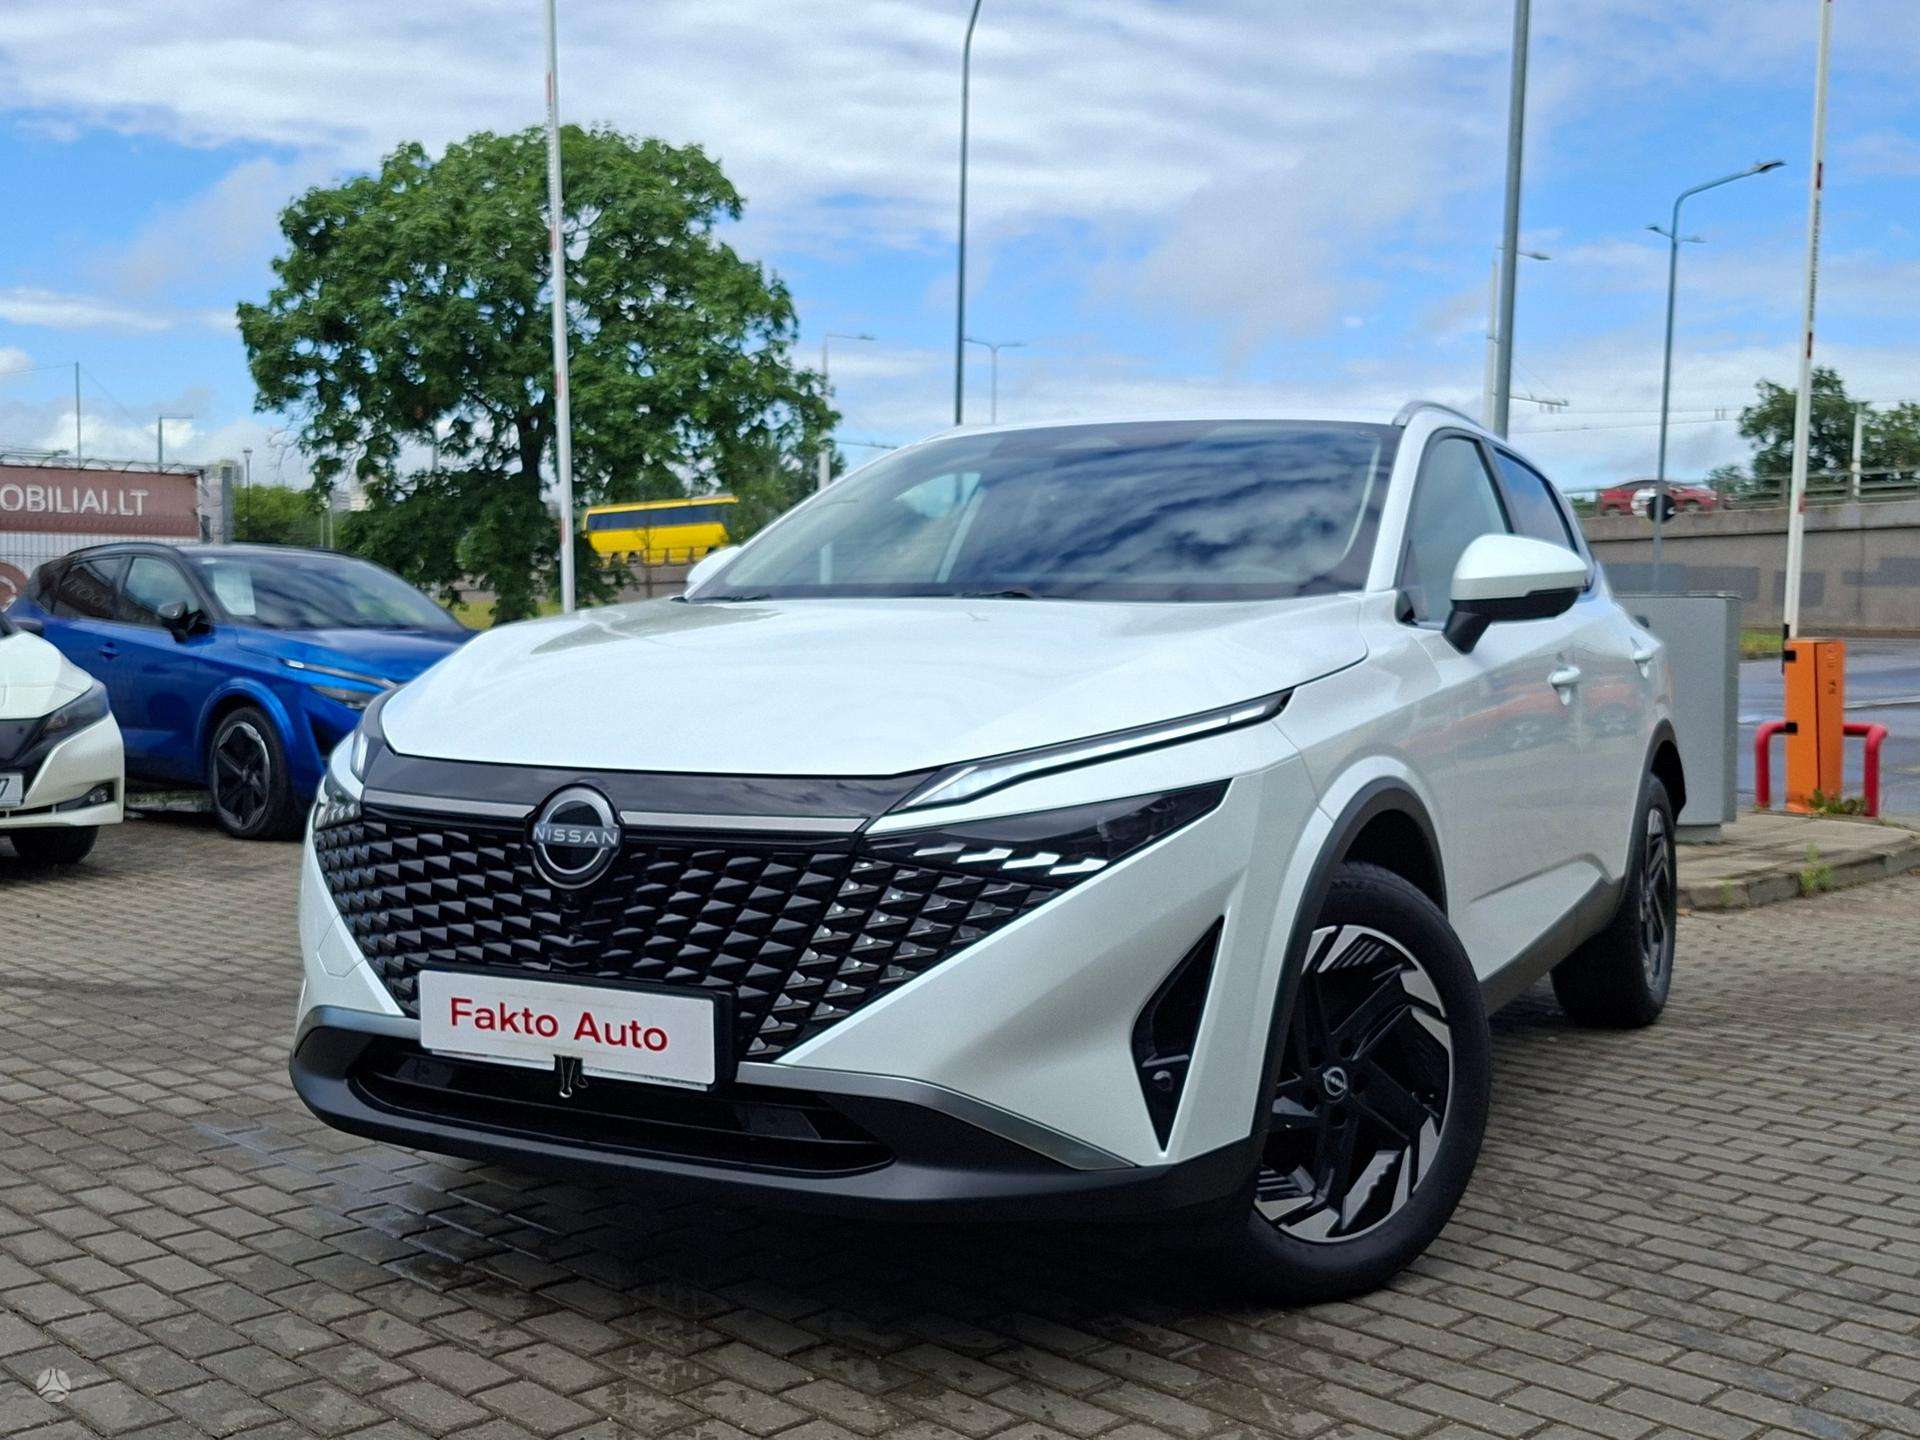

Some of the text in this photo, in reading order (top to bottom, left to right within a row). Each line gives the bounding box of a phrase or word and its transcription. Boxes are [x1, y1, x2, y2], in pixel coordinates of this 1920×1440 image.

[534, 826, 618, 845] NISSAN
[450, 997, 668, 1052] Fakto Auto
